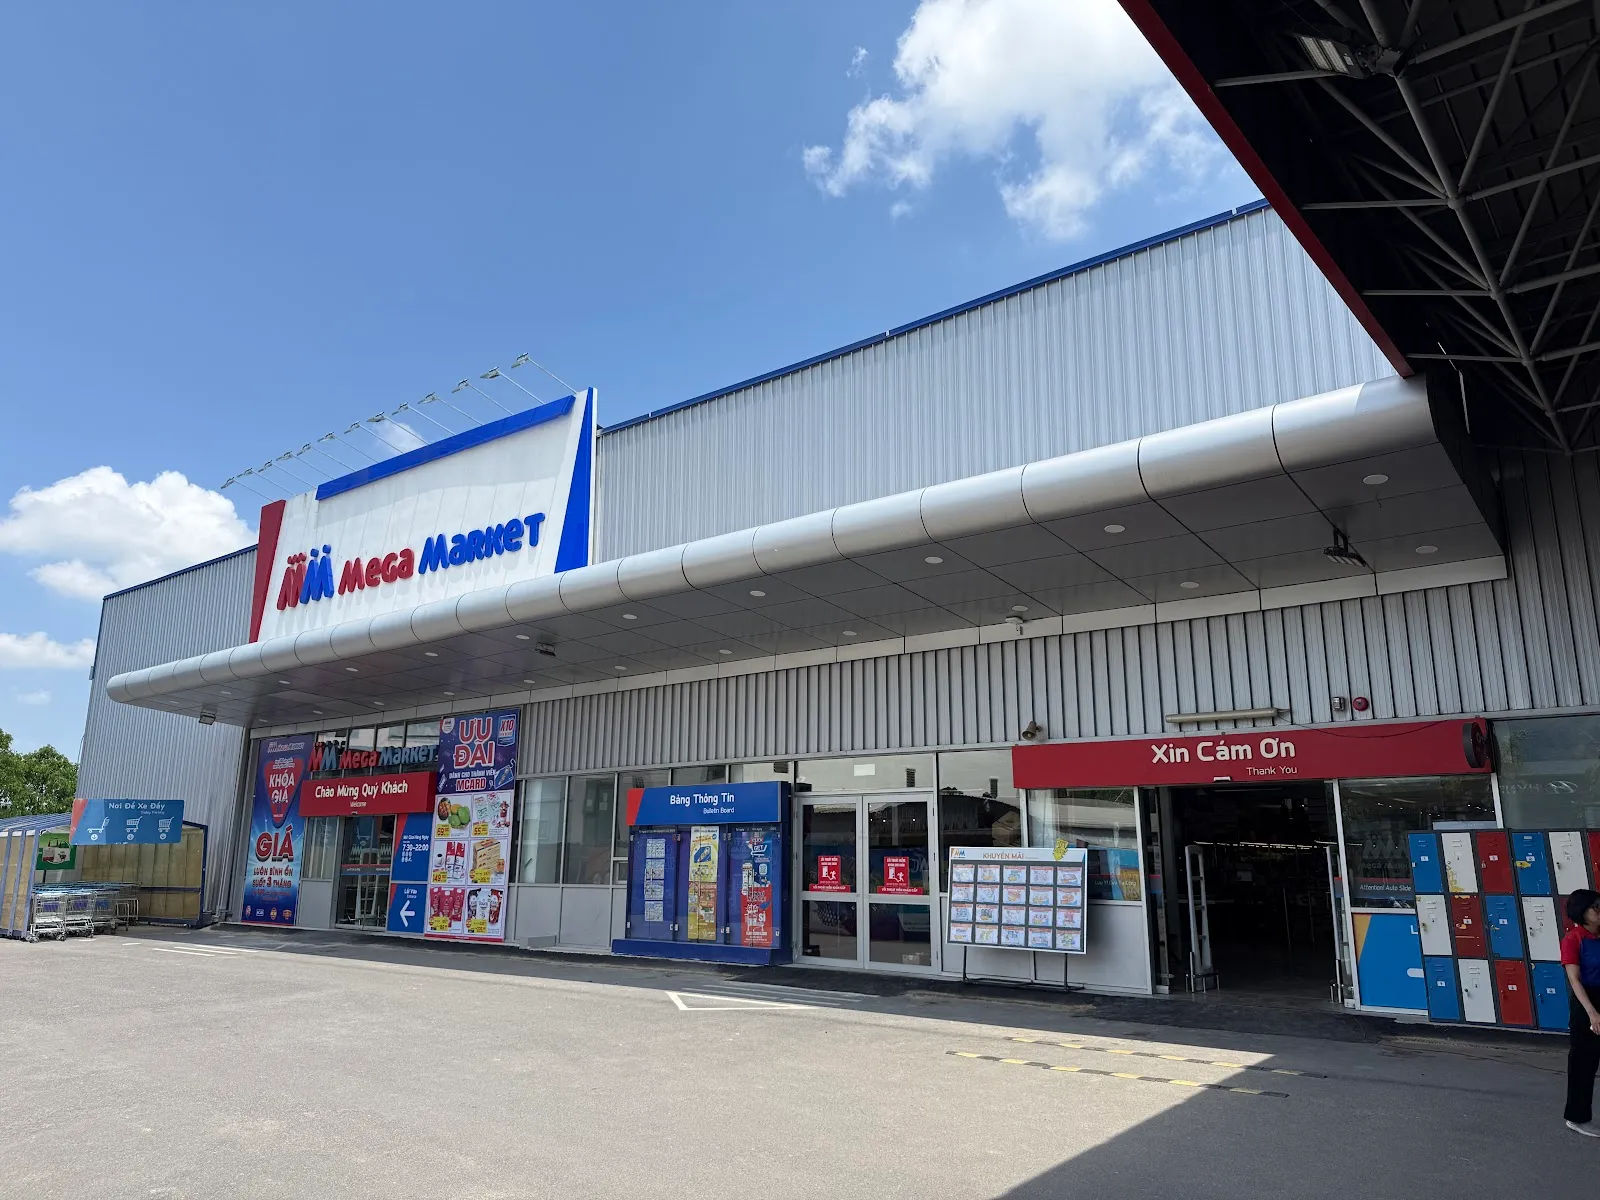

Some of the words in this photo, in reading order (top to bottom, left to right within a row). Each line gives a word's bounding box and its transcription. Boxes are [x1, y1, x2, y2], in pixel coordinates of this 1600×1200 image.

[1151, 743, 1190, 764] Xin
[1259, 737, 1296, 759] Ơn
[1246, 766, 1276, 776] Thank
[1279, 765, 1298, 775] You
[269, 769, 295, 788] KHÓA
[456, 777, 486, 792] MCARD
[381, 780, 408, 795] Khách
[721, 792, 735, 803] Tin
[255, 824, 295, 862] GIÁ
[267, 876, 272, 888] 3
[1399, 884, 1412, 892] Slide
